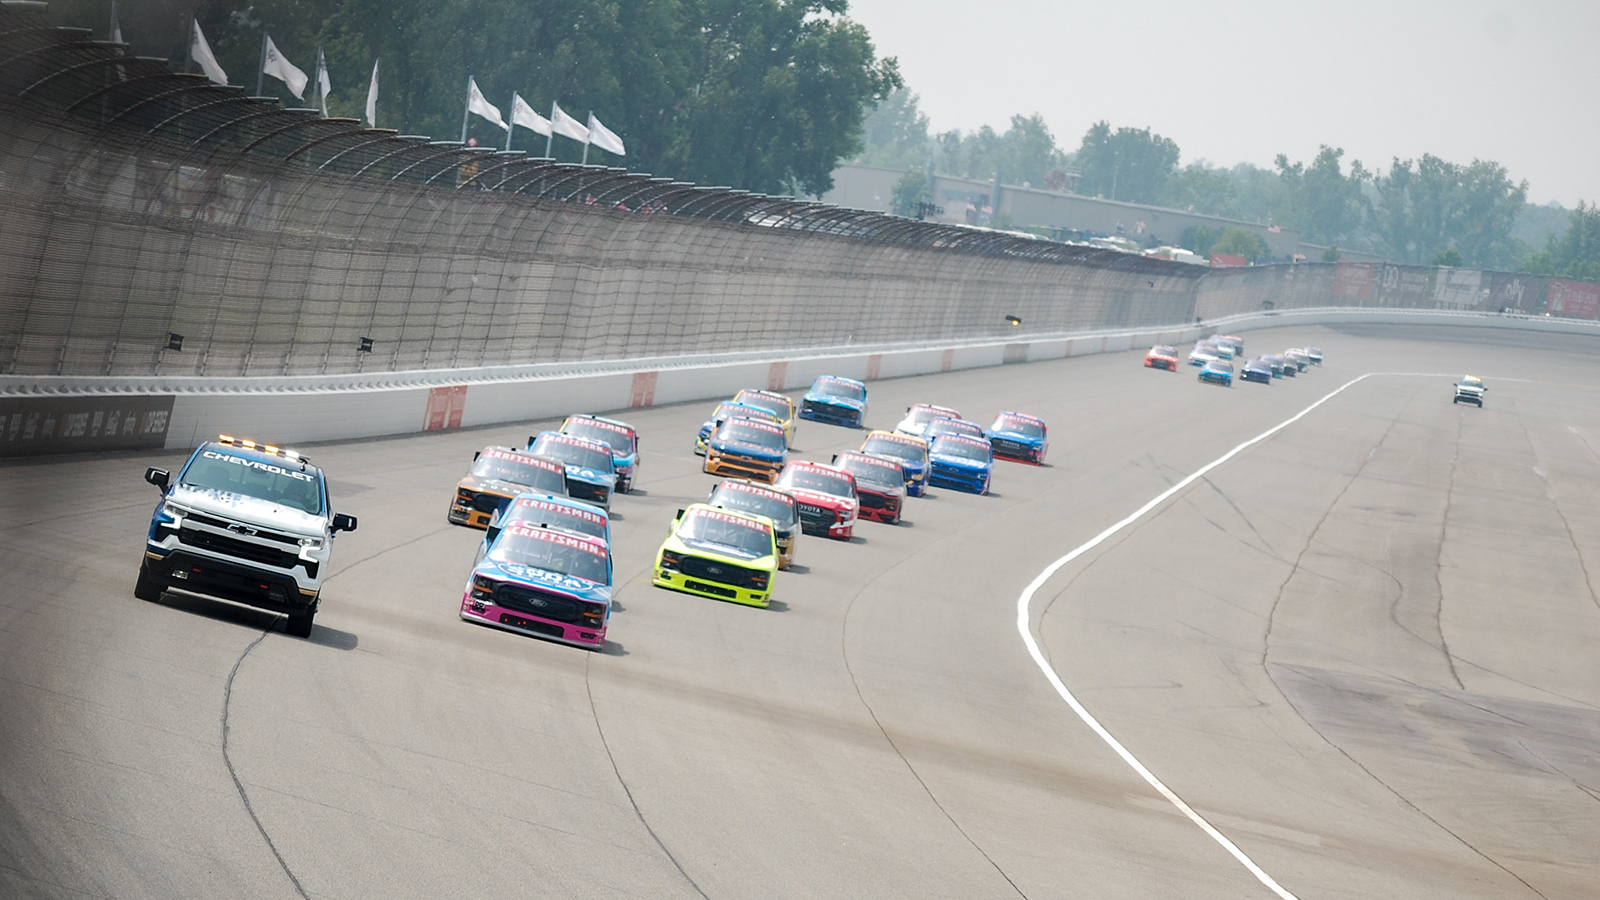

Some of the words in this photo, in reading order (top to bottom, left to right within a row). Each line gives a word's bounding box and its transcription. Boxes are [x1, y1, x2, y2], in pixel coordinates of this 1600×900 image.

[572, 417, 628, 434] CRAFTSMAN
[729, 418, 779, 434] CRAFTSMAN
[542, 434, 604, 453] CRAFTSMAN
[203, 451, 314, 482] CHEVROLET
[487, 449, 556, 471] CRAFTSMAN
[793, 464, 849, 482] CRAFTSMAN
[724, 481, 789, 502] CRAFTSMAN
[522, 499, 601, 523] CRAFTSMAN
[692, 508, 765, 531] CRAFTSMAN
[799, 504, 820, 514] OYOTA
[511, 526, 599, 554] CRAFTSMAN
